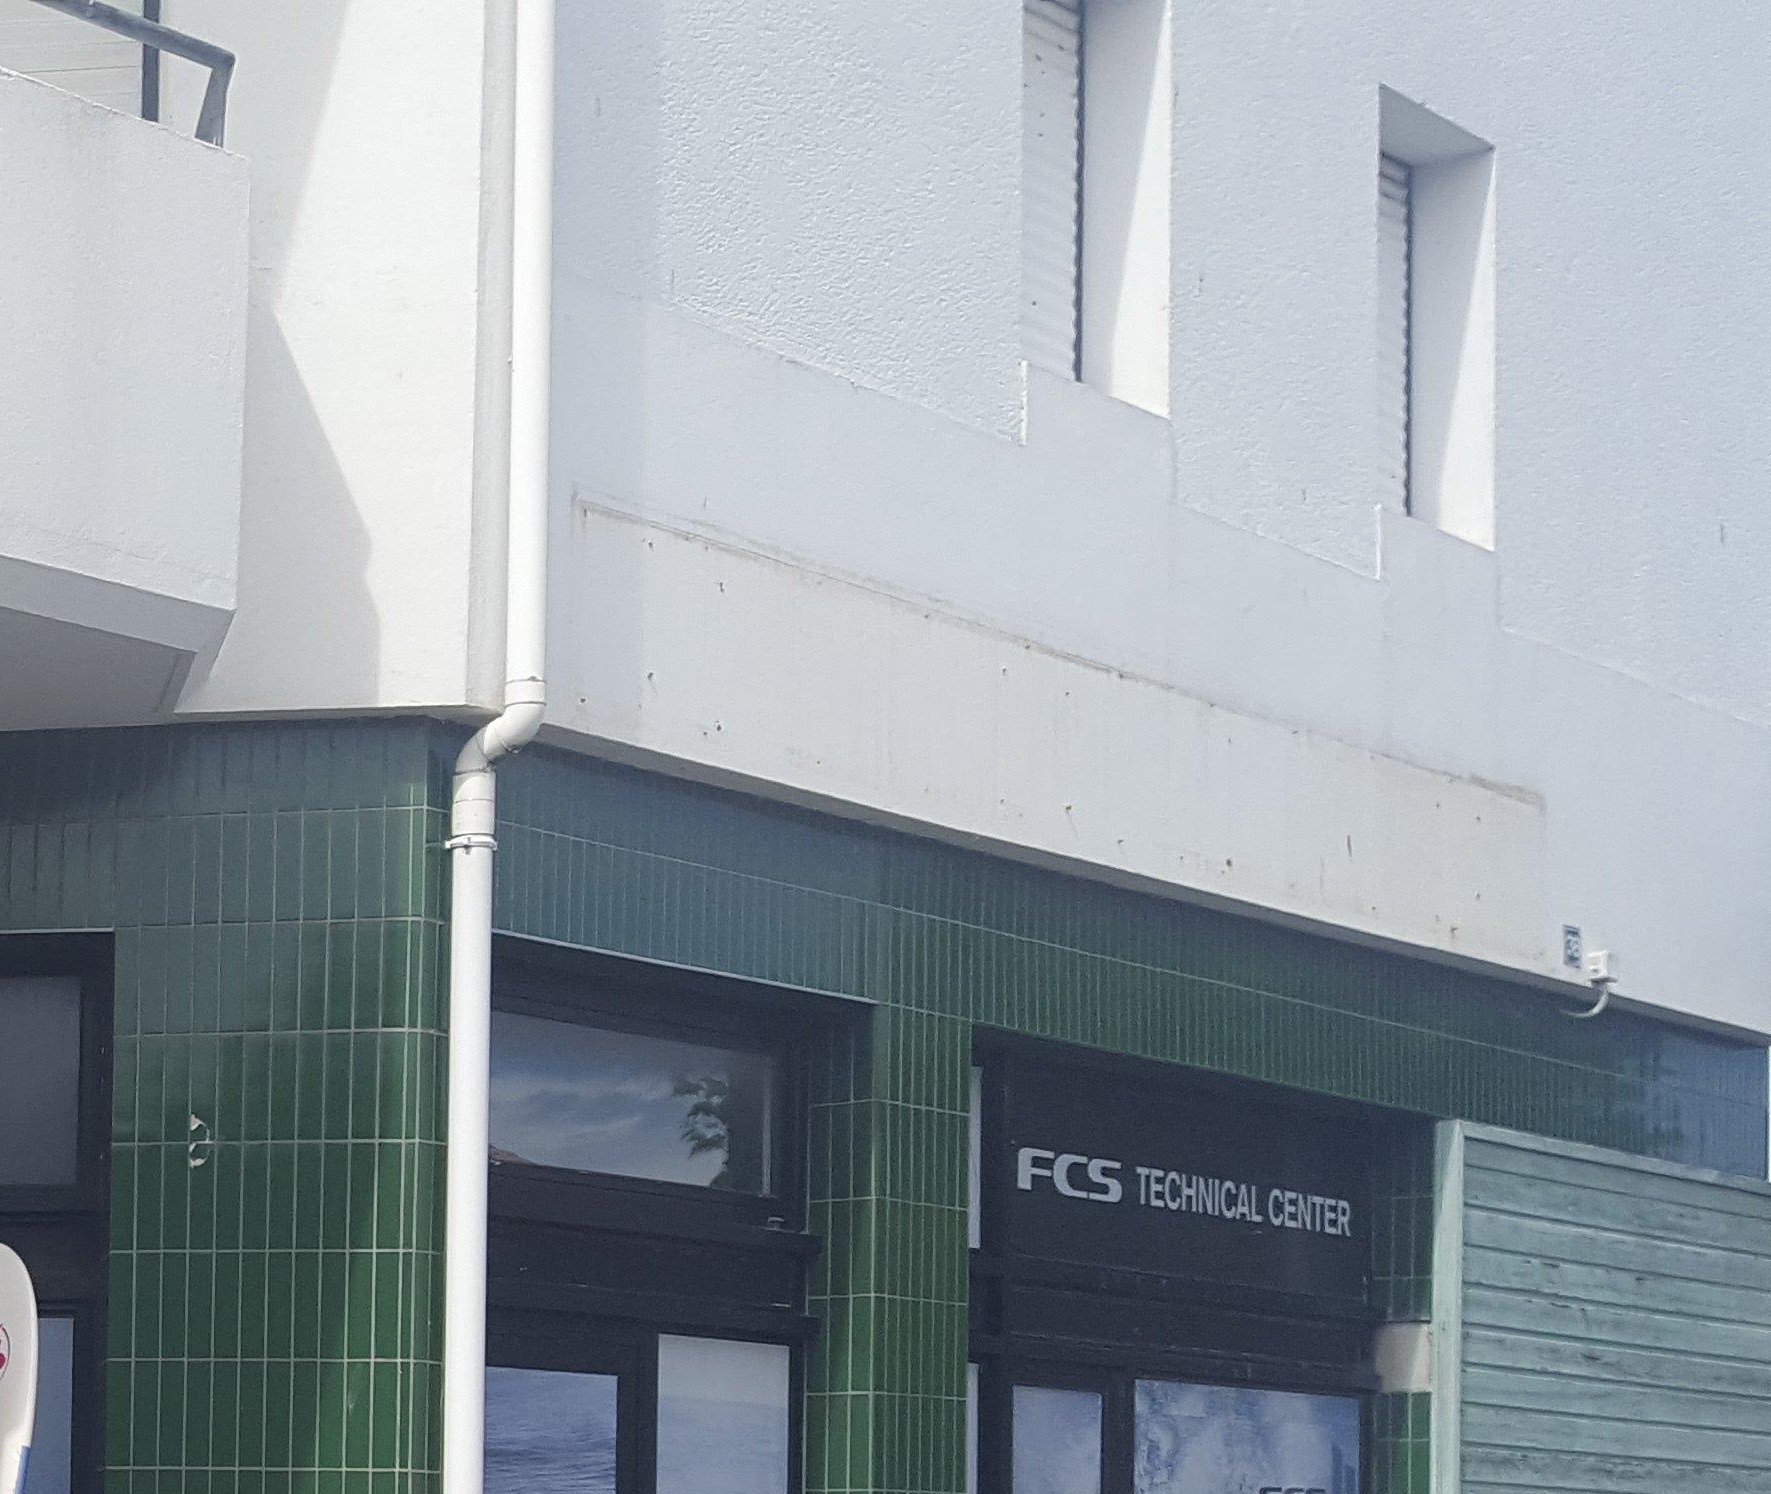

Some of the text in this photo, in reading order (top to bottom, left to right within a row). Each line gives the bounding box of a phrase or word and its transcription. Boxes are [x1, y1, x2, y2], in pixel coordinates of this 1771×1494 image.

[1017, 1147, 1351, 1237] FCS TECHNICAL CENTER
